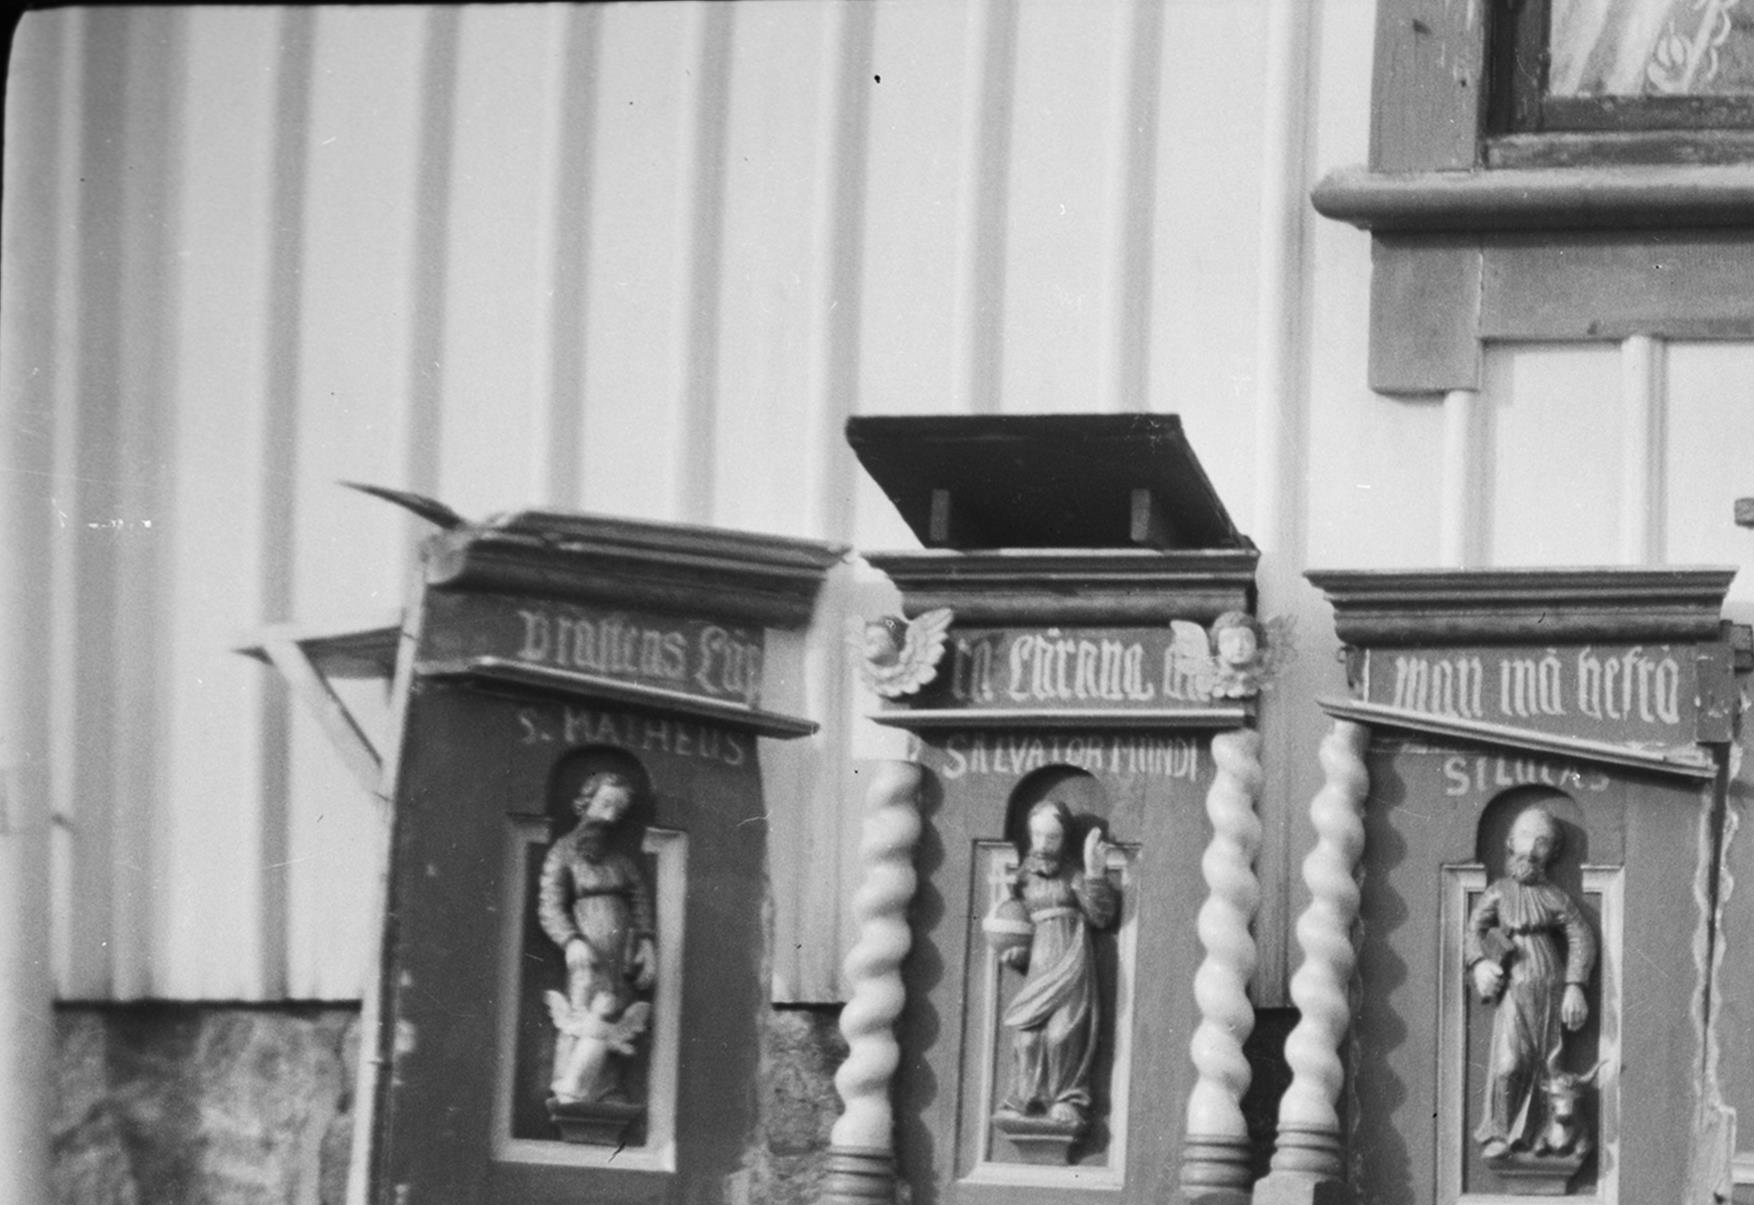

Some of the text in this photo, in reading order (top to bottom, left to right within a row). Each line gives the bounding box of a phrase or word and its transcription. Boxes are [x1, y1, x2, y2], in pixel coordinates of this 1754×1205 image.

[563, 705, 745, 766] MATHEUS
[942, 732, 1198, 782] SALVATOR MUNDI
